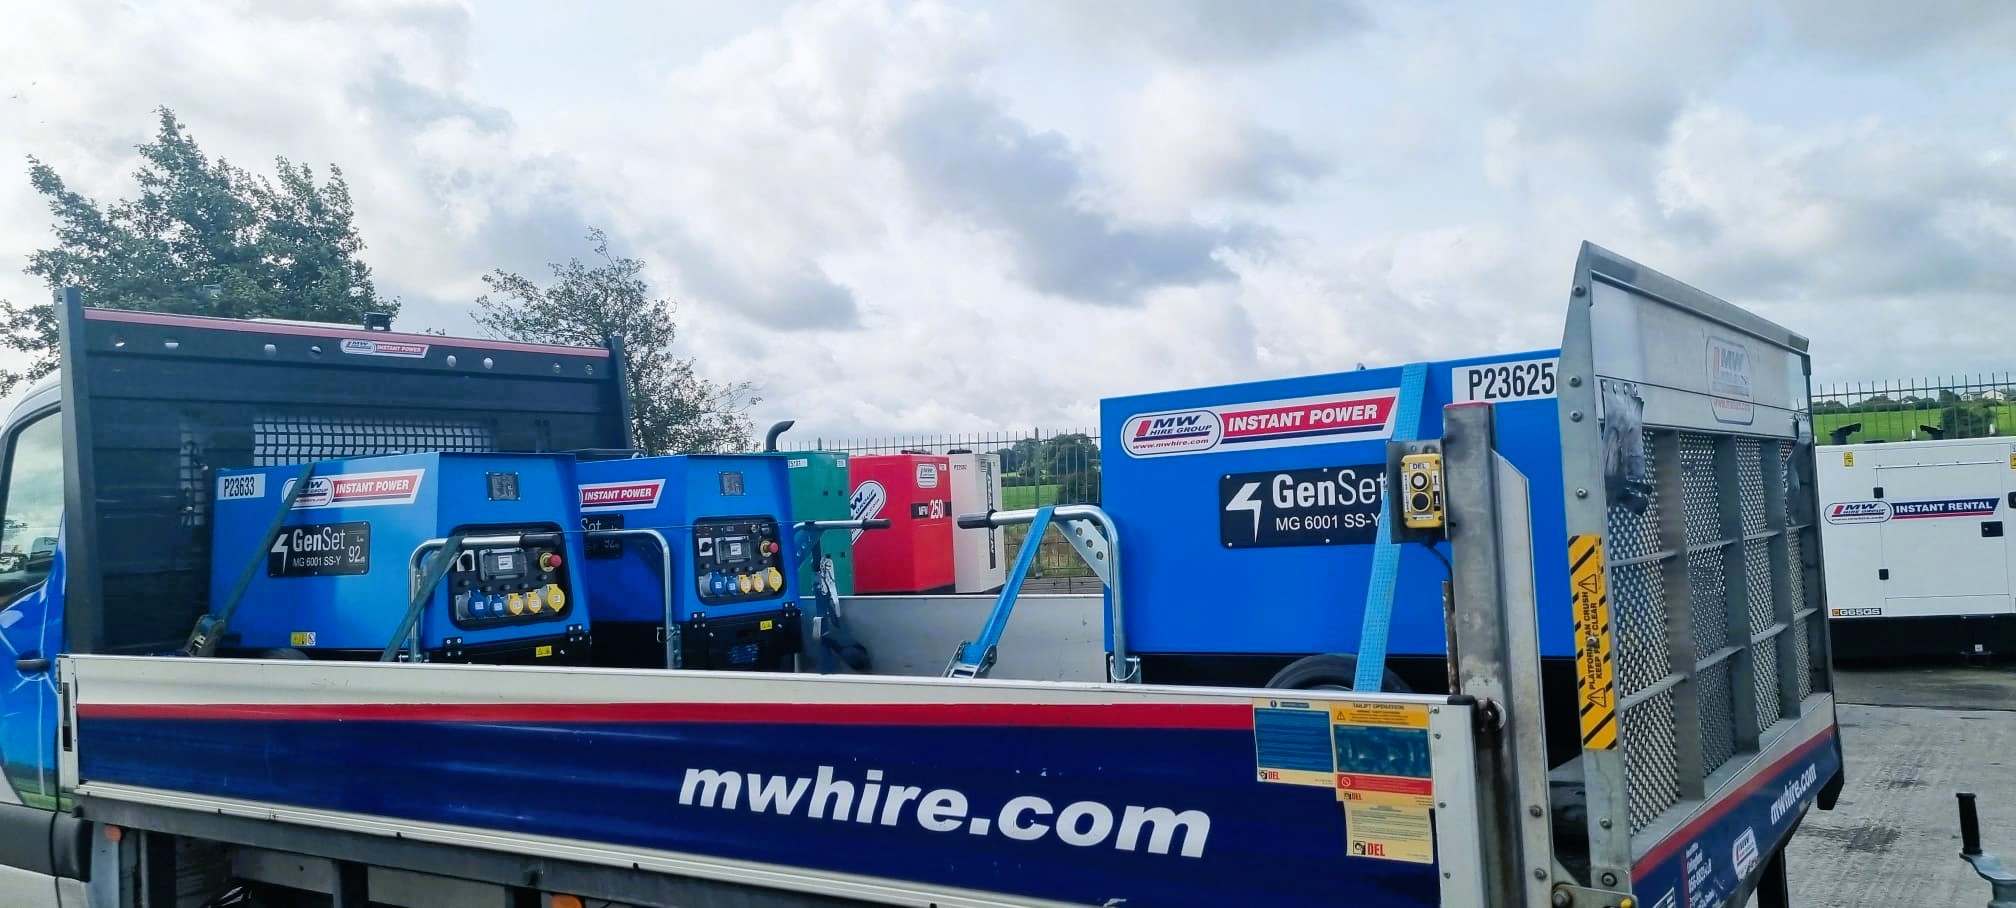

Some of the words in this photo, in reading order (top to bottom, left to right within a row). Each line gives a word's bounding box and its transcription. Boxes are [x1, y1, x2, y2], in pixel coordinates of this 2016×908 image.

[1468, 362, 1555, 400] P23625
[1153, 415, 1201, 428] MW
[1228, 411, 1304, 432] INSTANT
[1309, 404, 1378, 424] POWER
[1149, 428, 1174, 436] HIRE
[1176, 425, 1212, 433] GROUP
[1132, 438, 1209, 450] www.mwhire.com
[223, 476, 255, 498] P23633
[336, 481, 374, 494] INSTANT
[375, 479, 409, 492] POWER
[584, 489, 619, 501] INSTANT
[621, 487, 652, 498] POWER
[1272, 469, 1384, 509] GenSet
[929, 499, 943, 519] 250
[1845, 503, 1878, 511] MW
[1895, 502, 1945, 513] INSTANT
[1949, 501, 1993, 511] RENTAL
[1276, 517, 1300, 531] MG
[1304, 514, 1338, 530] 6001
[1344, 512, 1381, 528] SS-Y
[292, 526, 346, 552] GenSet
[292, 557, 305, 567] MG
[306, 556, 322, 567] 6001
[323, 555, 341, 566] SS-Y
[348, 545, 361, 563] 92
[1583, 591, 1591, 621] CRUSH
[1591, 602, 1599, 631] CLEAR
[1268, 771, 1280, 781] DEL
[1351, 792, 1362, 800] DEL
[1770, 763, 1817, 825] mwhire.com
[678, 766, 1211, 859] mwhire.com
[1367, 842, 1386, 857] DEL
